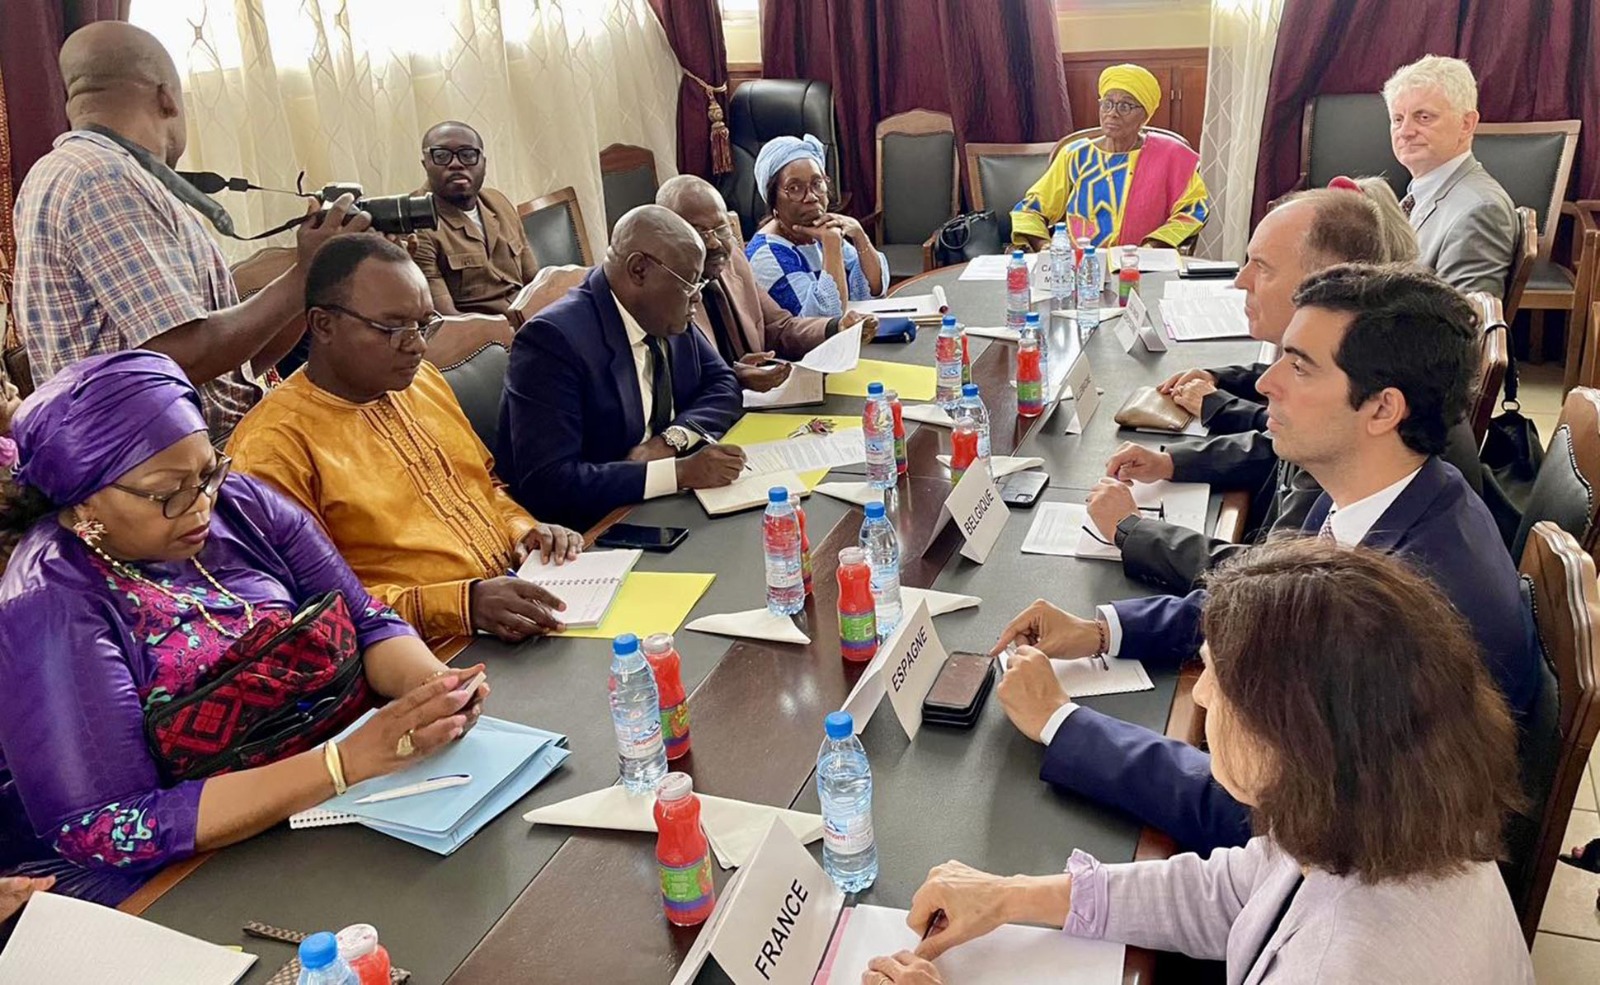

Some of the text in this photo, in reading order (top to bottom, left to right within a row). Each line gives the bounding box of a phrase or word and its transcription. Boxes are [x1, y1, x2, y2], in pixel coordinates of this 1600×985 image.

[963, 488, 995, 536] BELGIQUE
[891, 625, 928, 693] ESPAGNE
[754, 878, 809, 981] FRANCE
